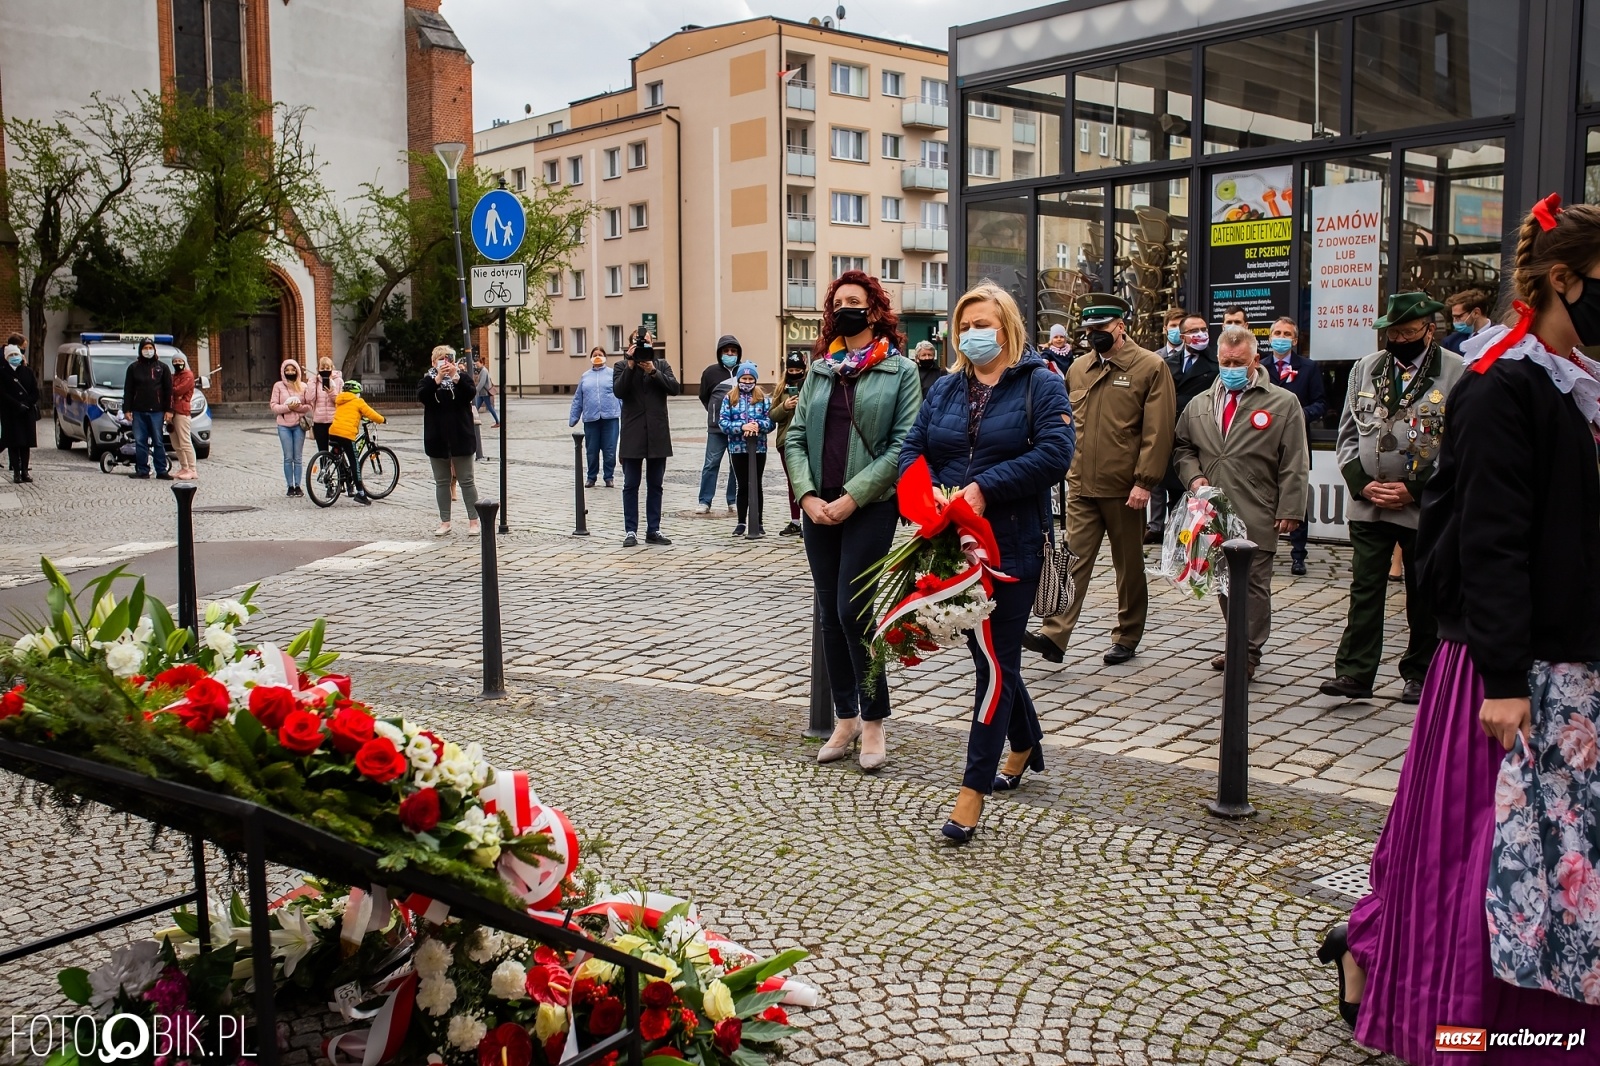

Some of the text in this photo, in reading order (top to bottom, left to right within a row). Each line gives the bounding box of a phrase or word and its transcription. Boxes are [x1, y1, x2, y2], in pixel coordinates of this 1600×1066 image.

[1316, 209, 1379, 233] ZAMÓW
[1213, 221, 1292, 243] CATERING DIETETYCZNY
[1318, 234, 1376, 248] Z DOWOZEM
[1245, 246, 1290, 258] BEZ PSZENICY
[1335, 249, 1356, 260] LUB
[473, 268, 522, 279] Nie dotyczy
[1320, 263, 1373, 275] ODBIOREM
[1320, 277, 1372, 289] W LOKALU
[1213, 290, 1232, 299] ZDROWA
[1235, 288, 1271, 298] ZBILANSOWANA
[1317, 304, 1374, 316] 32 415 84 84
[1317, 318, 1373, 329] 32 415 74 75
